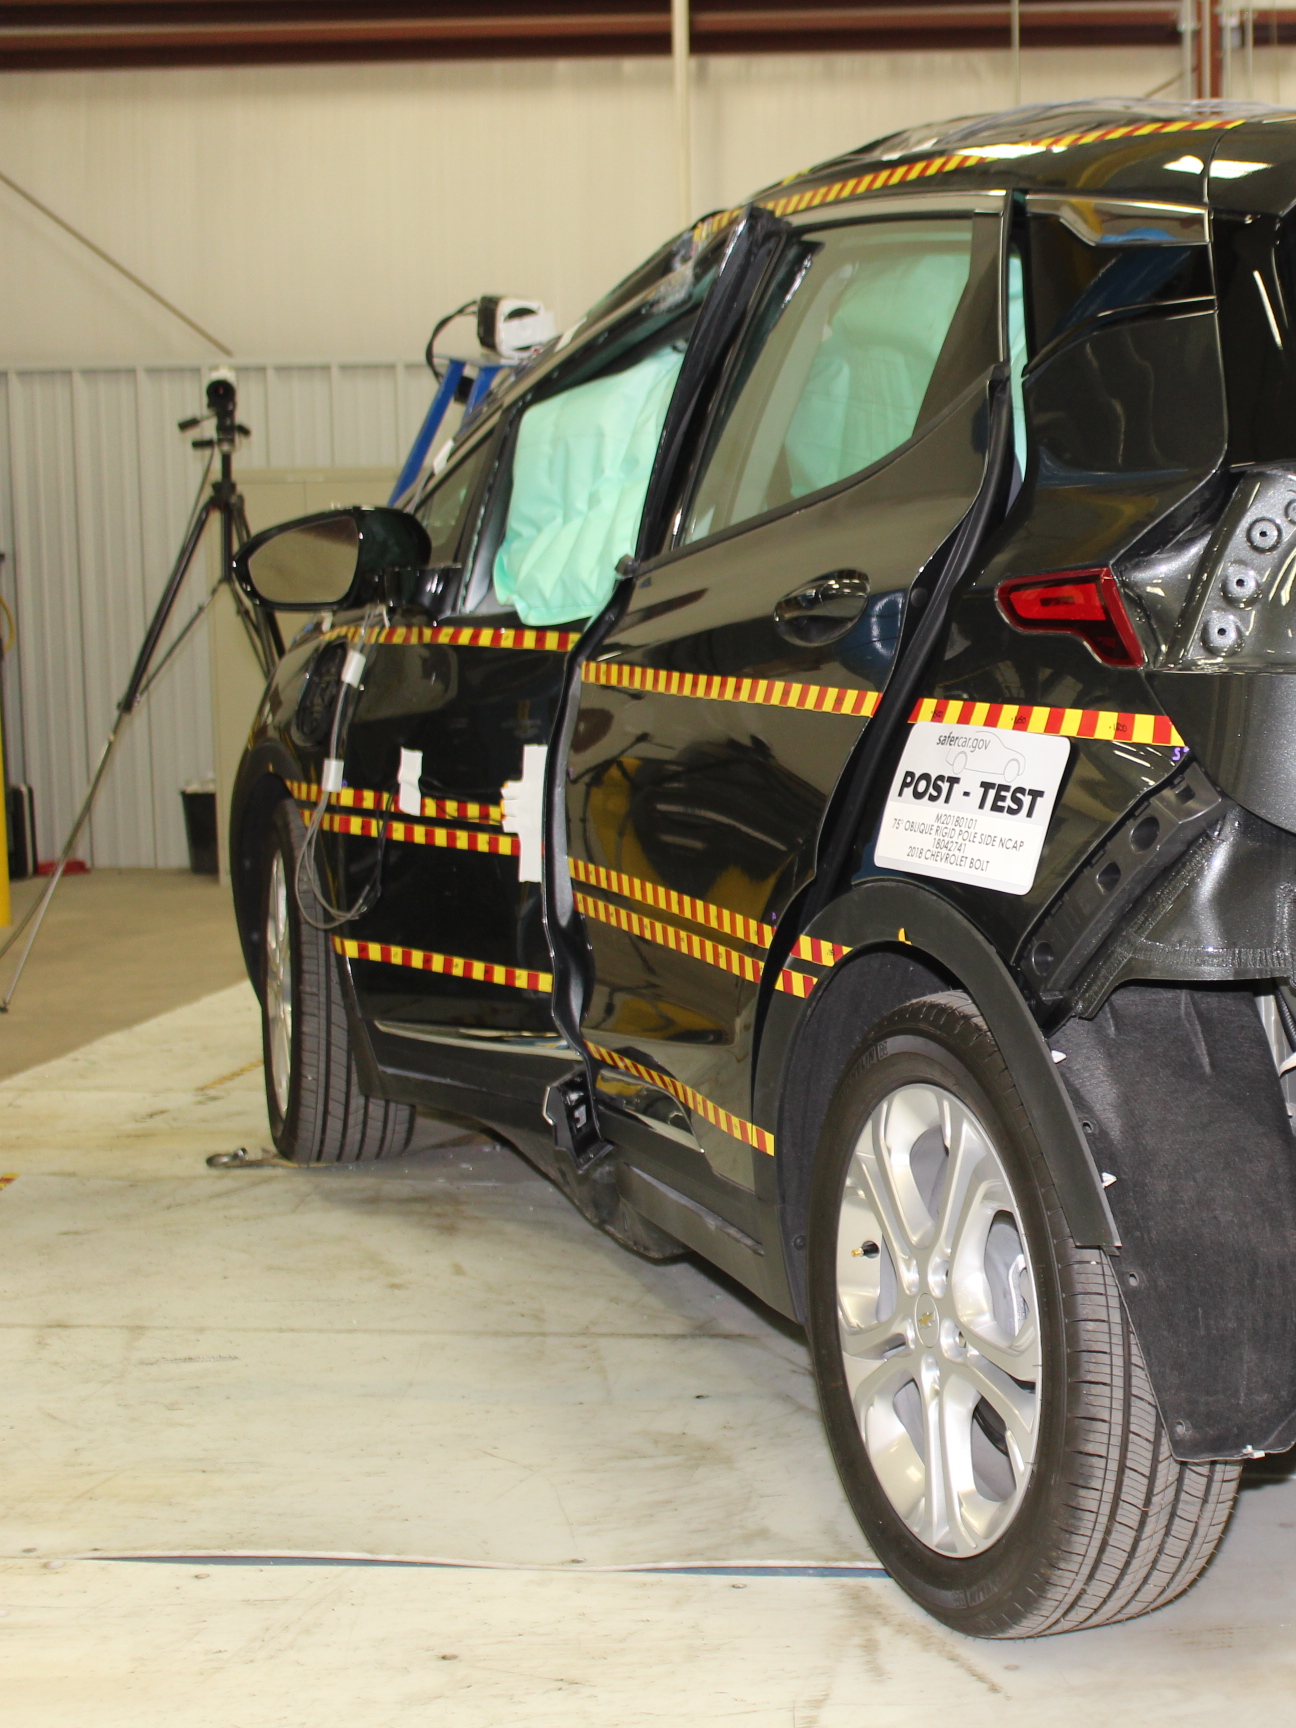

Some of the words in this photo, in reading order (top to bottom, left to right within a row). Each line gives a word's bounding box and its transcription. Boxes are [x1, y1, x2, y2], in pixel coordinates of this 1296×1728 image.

[936, 731, 991, 751] safercar.gov
[898, 771, 961, 805] POST
[978, 781, 1044, 819] TEST
[934, 813, 978, 830] M20180101
[904, 820, 934, 836] OBLIQUE
[935, 826, 957, 839] RIGID
[957, 829, 977, 844] POLE
[978, 833, 997, 848] SIDE
[998, 837, 1025, 852] NCAP
[932, 838, 967, 854] 18042741
[907, 846, 924, 857] 2018
[924, 849, 969, 867] CHEVROLET
[969, 858, 990, 872] BOLT
